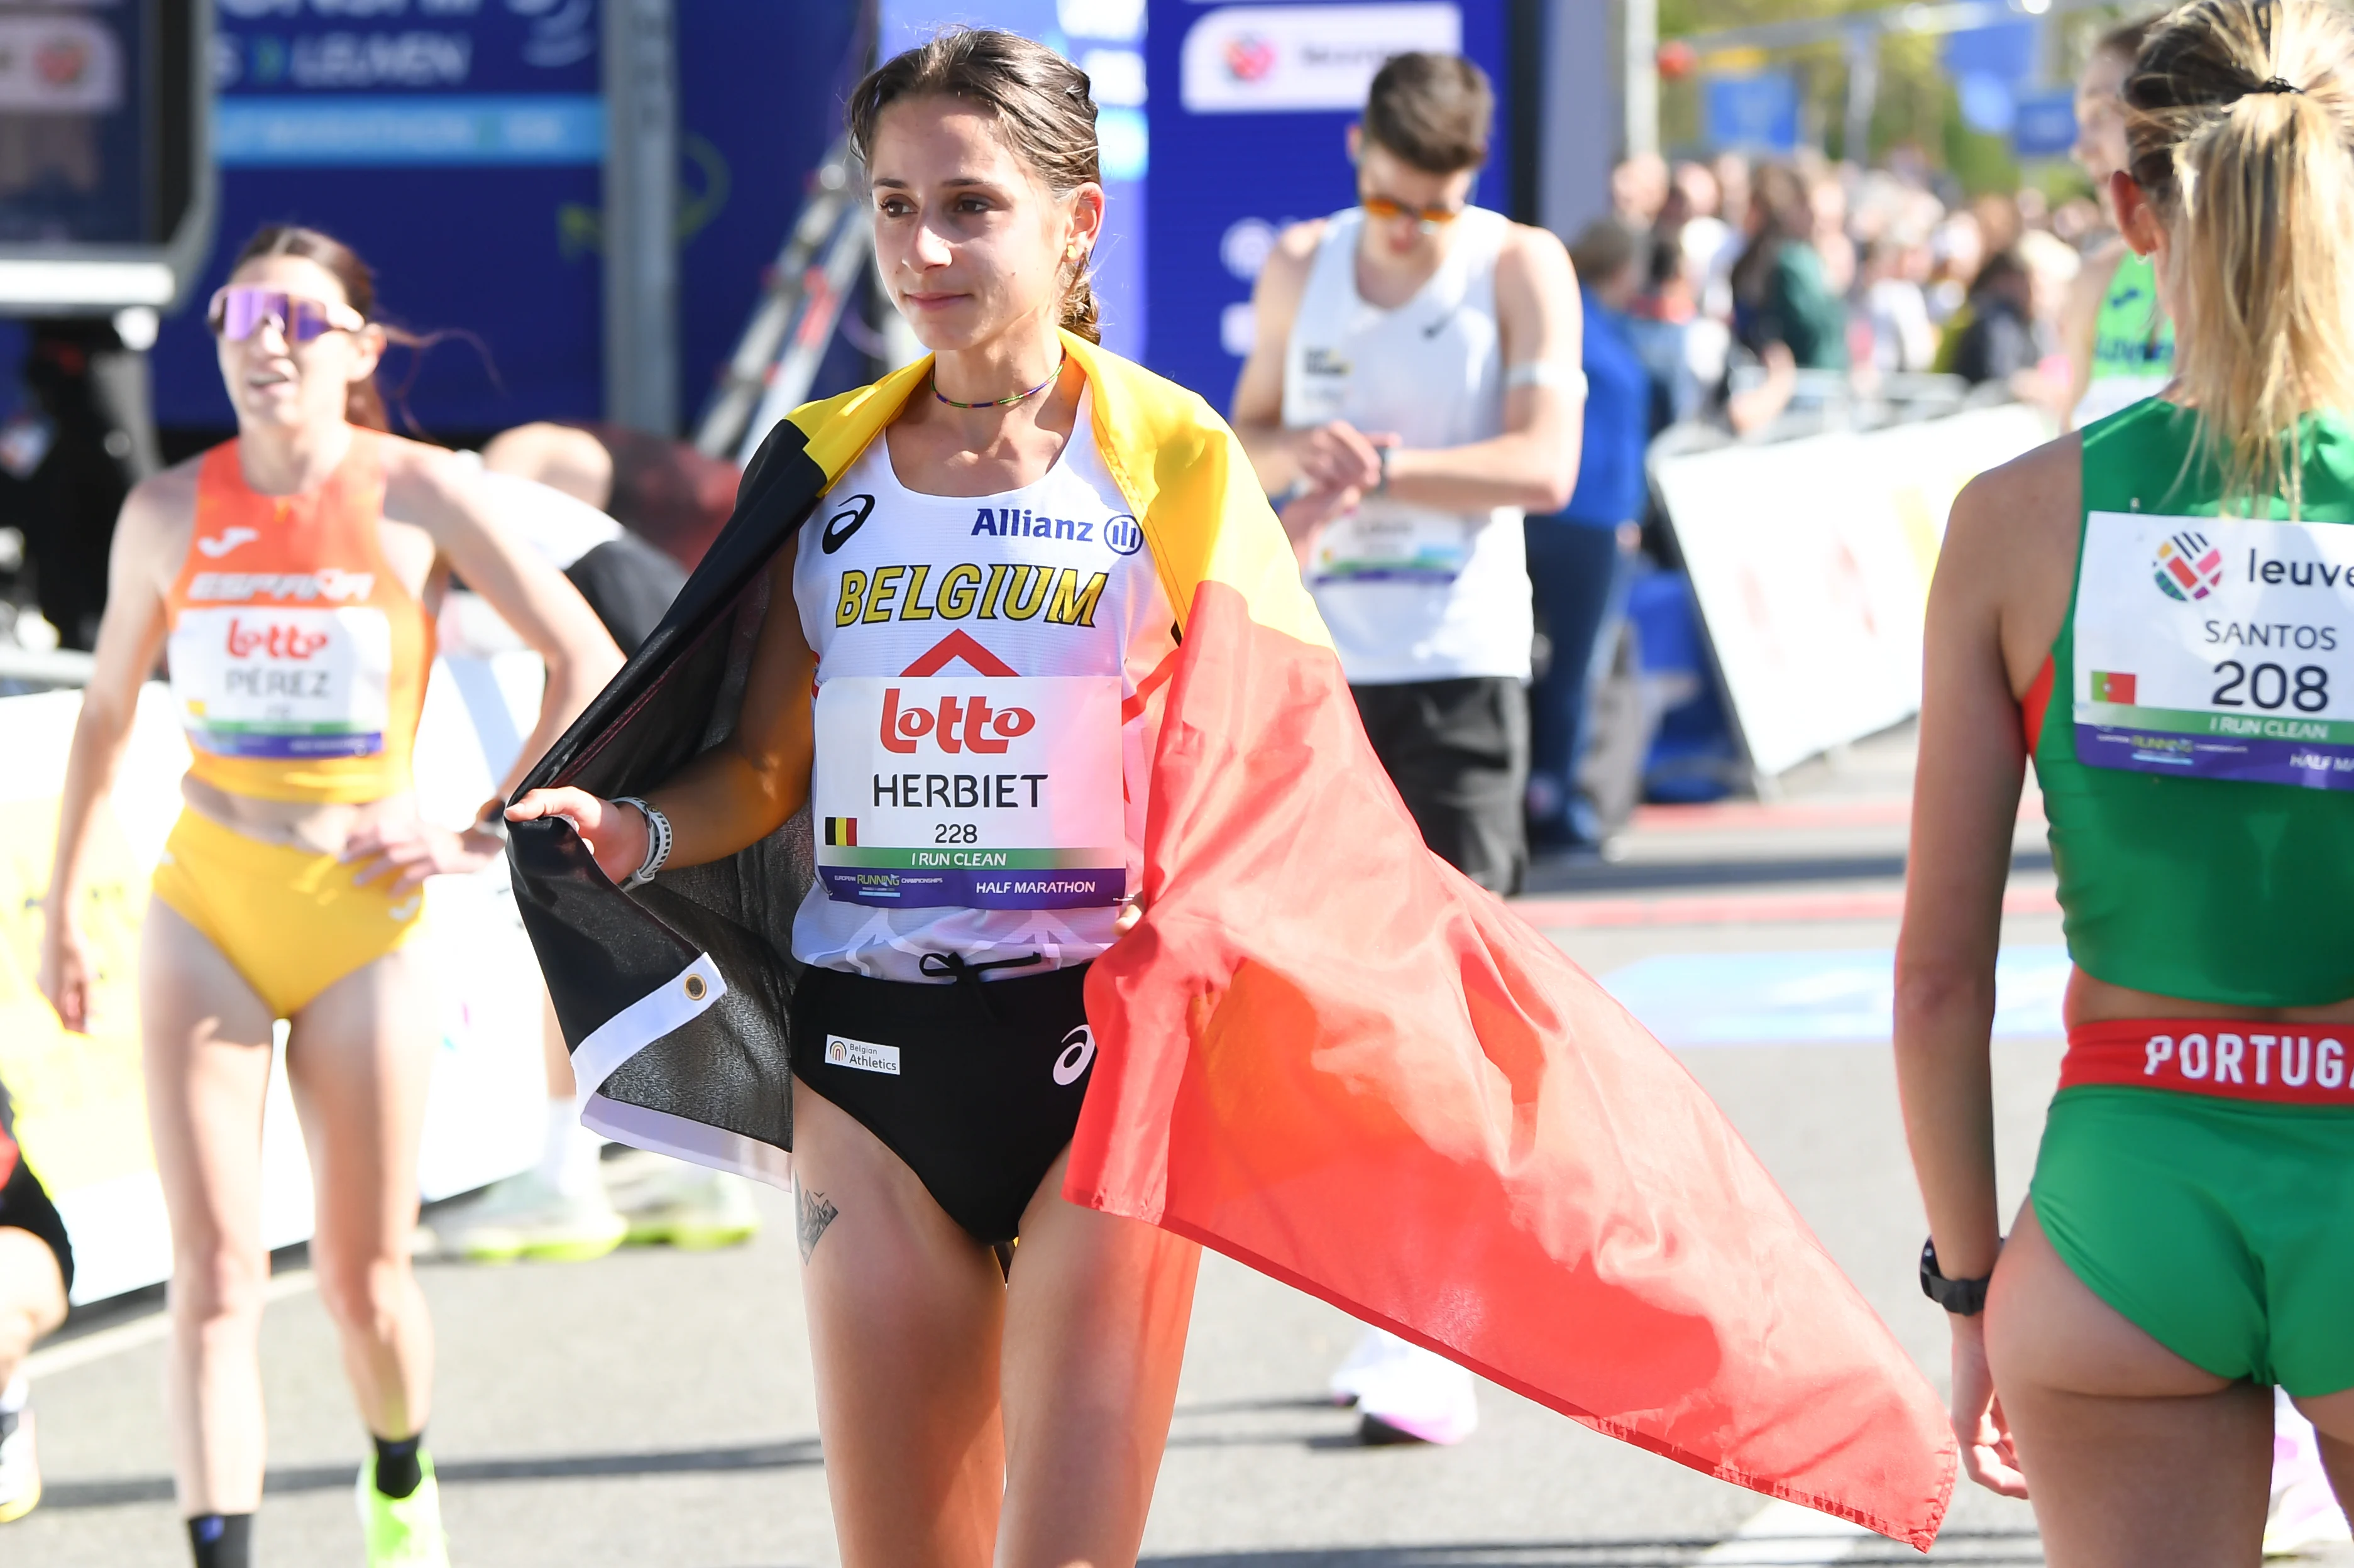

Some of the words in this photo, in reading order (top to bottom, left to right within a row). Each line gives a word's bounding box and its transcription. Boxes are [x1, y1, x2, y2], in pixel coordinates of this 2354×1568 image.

[971, 508, 1093, 542] Allianz
[836, 563, 1109, 627] BELGIUM
[227, 618, 329, 659] lotto
[2205, 620, 2337, 650] SANTOS
[2211, 661, 2329, 712] 208
[880, 688, 1035, 754] lotto
[2209, 717, 2216, 731] I
[2219, 717, 2261, 735] RUN
[2265, 720, 2328, 738] CLEAN
[873, 774, 1048, 808] HERBIET
[935, 823, 978, 843] 228
[911, 853, 917, 866] I
[918, 853, 950, 866] RUN
[954, 853, 1007, 866] CLEAN
[857, 874, 899, 886] RUNNING
[976, 882, 1012, 893] HALF
[1014, 881, 1096, 894] MARATHON
[849, 1043, 877, 1055] Belgian
[849, 1054, 897, 1070] Athletics
[2143, 1033, 2354, 1089] PORTUG
